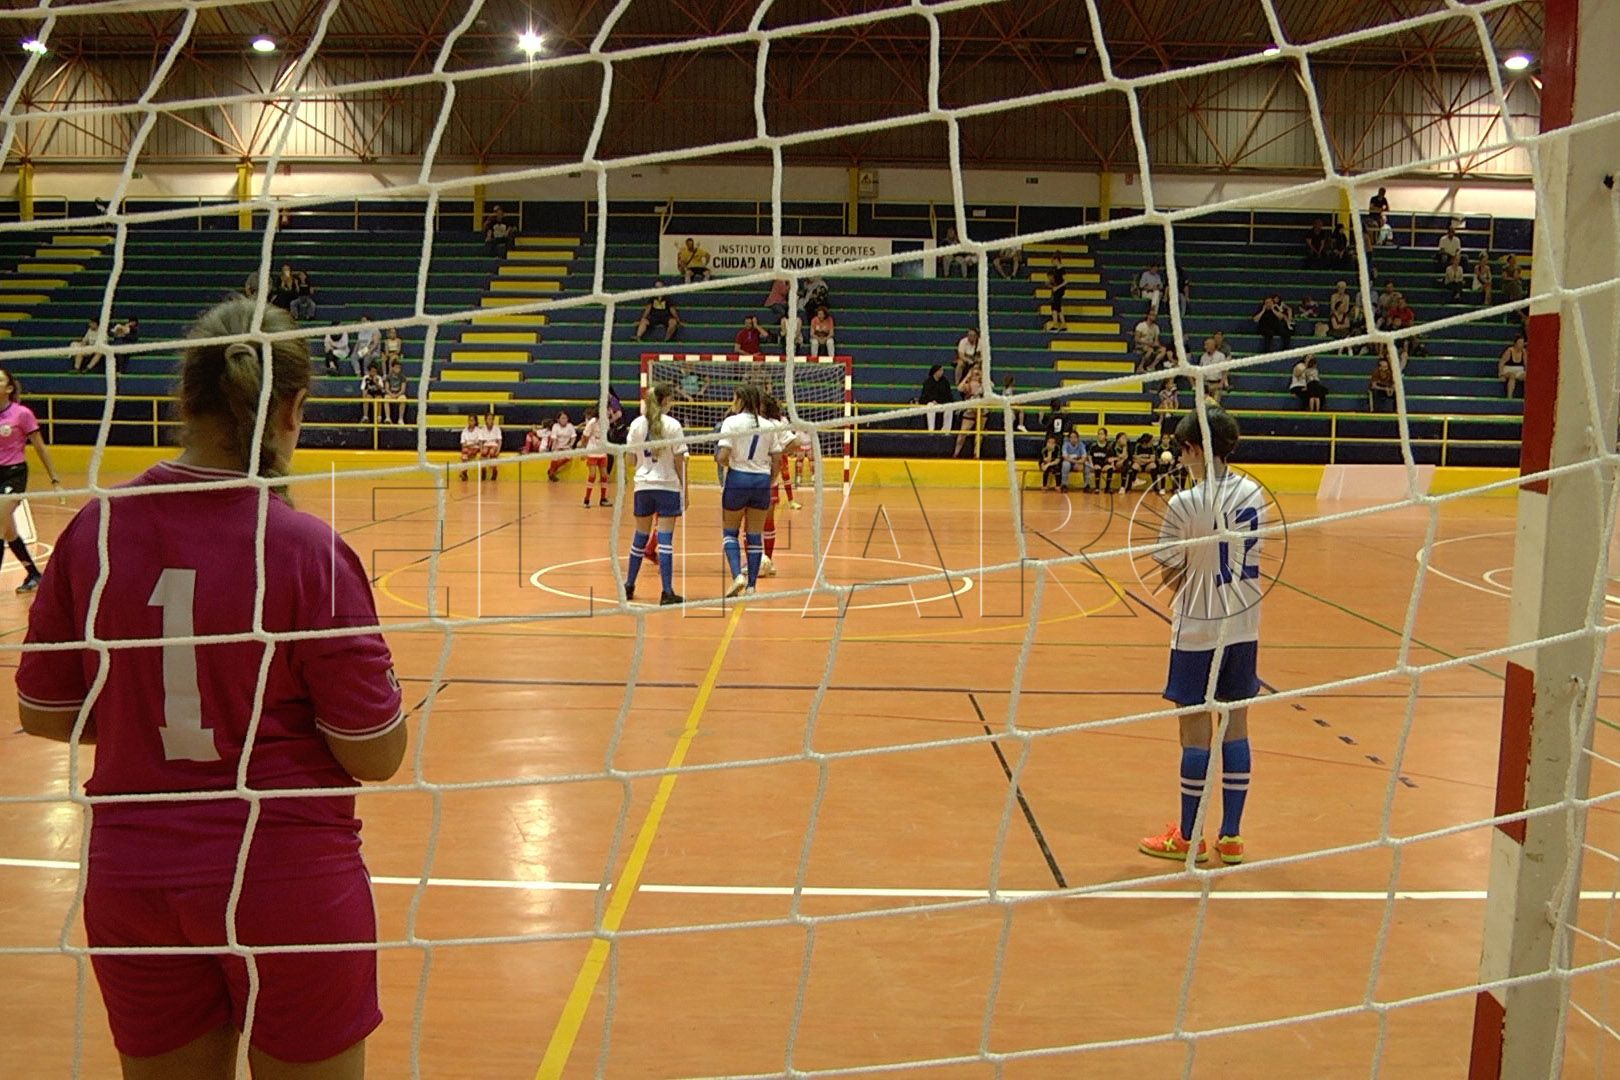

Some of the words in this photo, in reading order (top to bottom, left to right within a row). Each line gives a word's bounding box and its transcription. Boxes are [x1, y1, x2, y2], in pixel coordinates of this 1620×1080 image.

[712, 256, 756, 269] CIUDAD
[760, 256, 822, 270] AUONOMA
[718, 244, 771, 255] INSTITUTO
[775, 244, 804, 255] EUTI
[806, 245, 820, 255] DE
[822, 244, 876, 256] DEPORTES
[1213, 507, 1259, 588] 12
[148, 568, 222, 762] 1
